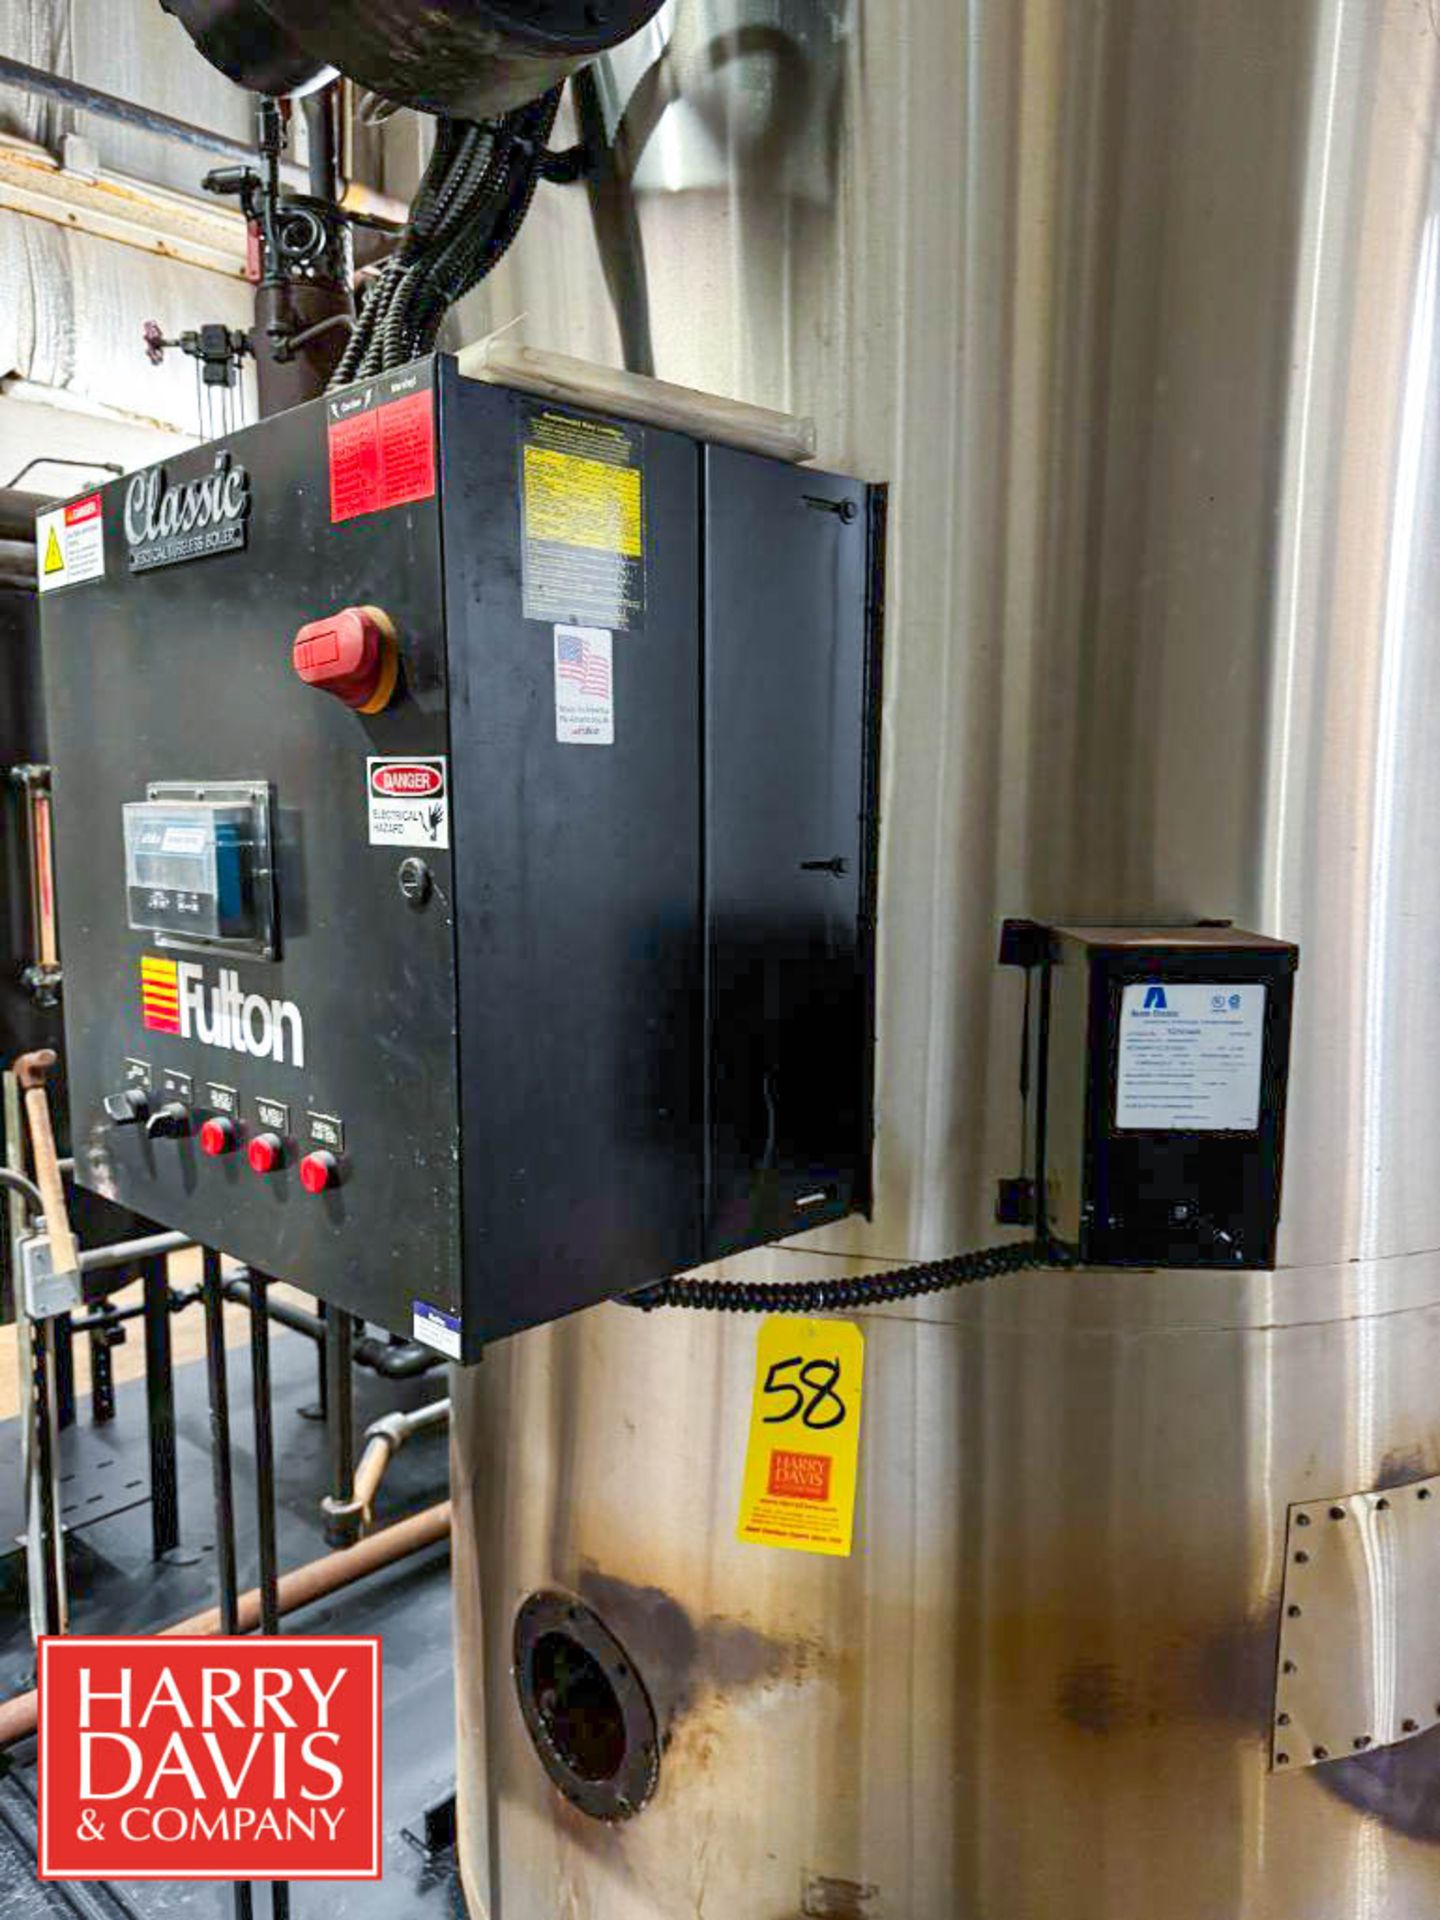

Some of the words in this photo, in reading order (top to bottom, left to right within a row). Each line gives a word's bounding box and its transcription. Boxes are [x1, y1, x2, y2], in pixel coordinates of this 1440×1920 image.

[124, 456, 243, 545] Classic
[383, 771, 431, 790] DANGER
[178, 961, 304, 1068] Fulton
[763, 1356, 846, 1429] 58
[775, 1467, 824, 1487] DAVIS
[776, 1454, 826, 1475] HARRY
